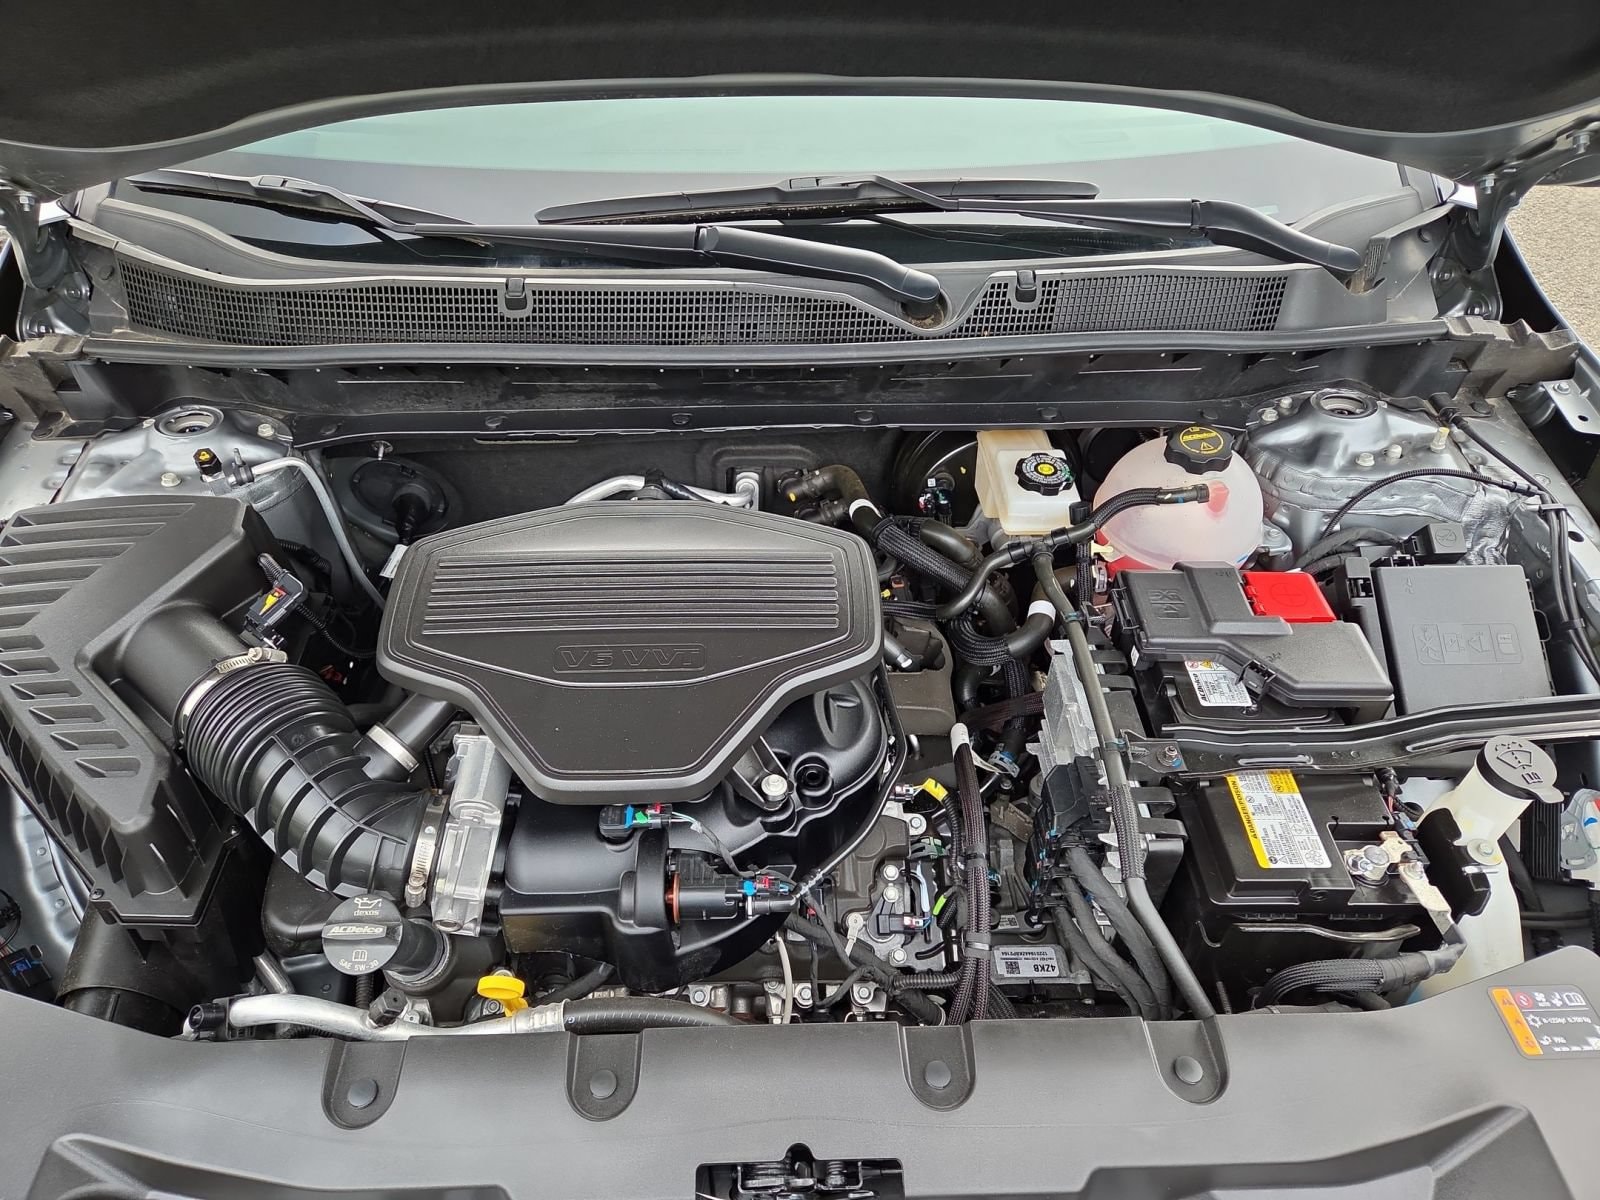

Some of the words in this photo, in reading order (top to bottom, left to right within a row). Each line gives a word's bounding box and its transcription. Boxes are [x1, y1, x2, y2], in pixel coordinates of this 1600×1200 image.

[560, 650, 613, 667] V6
[622, 648, 700, 666] VVT
[329, 925, 384, 935] ACDelco
[338, 959, 352, 970] SAE
[354, 959, 379, 971] 5W-30
[1033, 964, 1056, 972] 4ZKB
